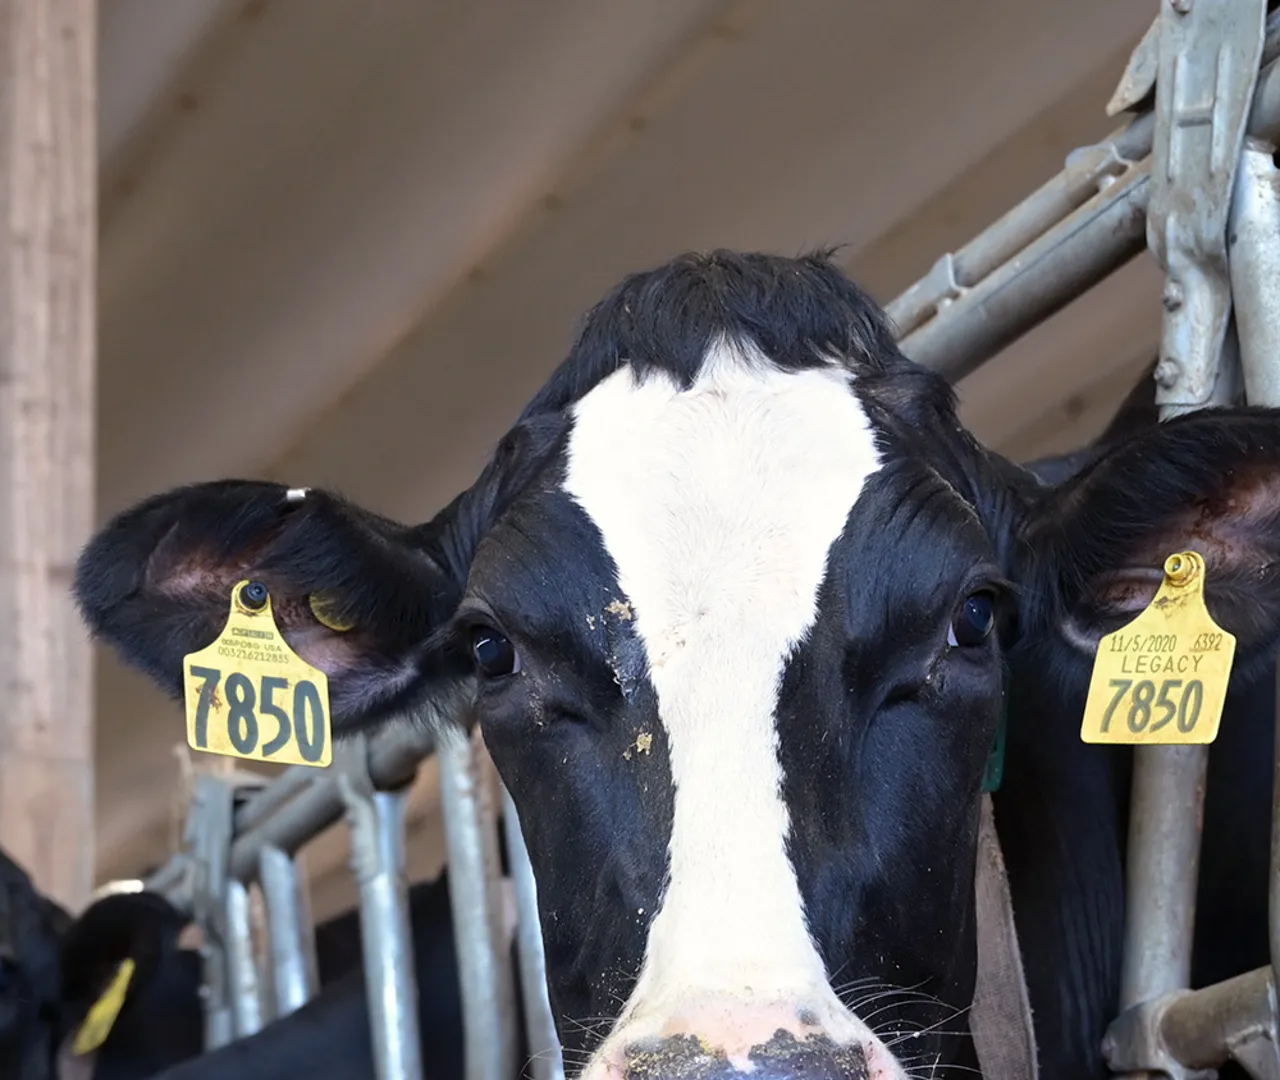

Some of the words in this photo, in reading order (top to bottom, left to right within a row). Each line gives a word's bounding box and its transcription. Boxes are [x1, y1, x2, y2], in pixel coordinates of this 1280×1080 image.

[1109, 634, 1178, 652] 11/5/2020
[1121, 654, 1203, 673] LEGACY
[190, 664, 325, 762] 7850
[1100, 679, 1203, 734] 7850
